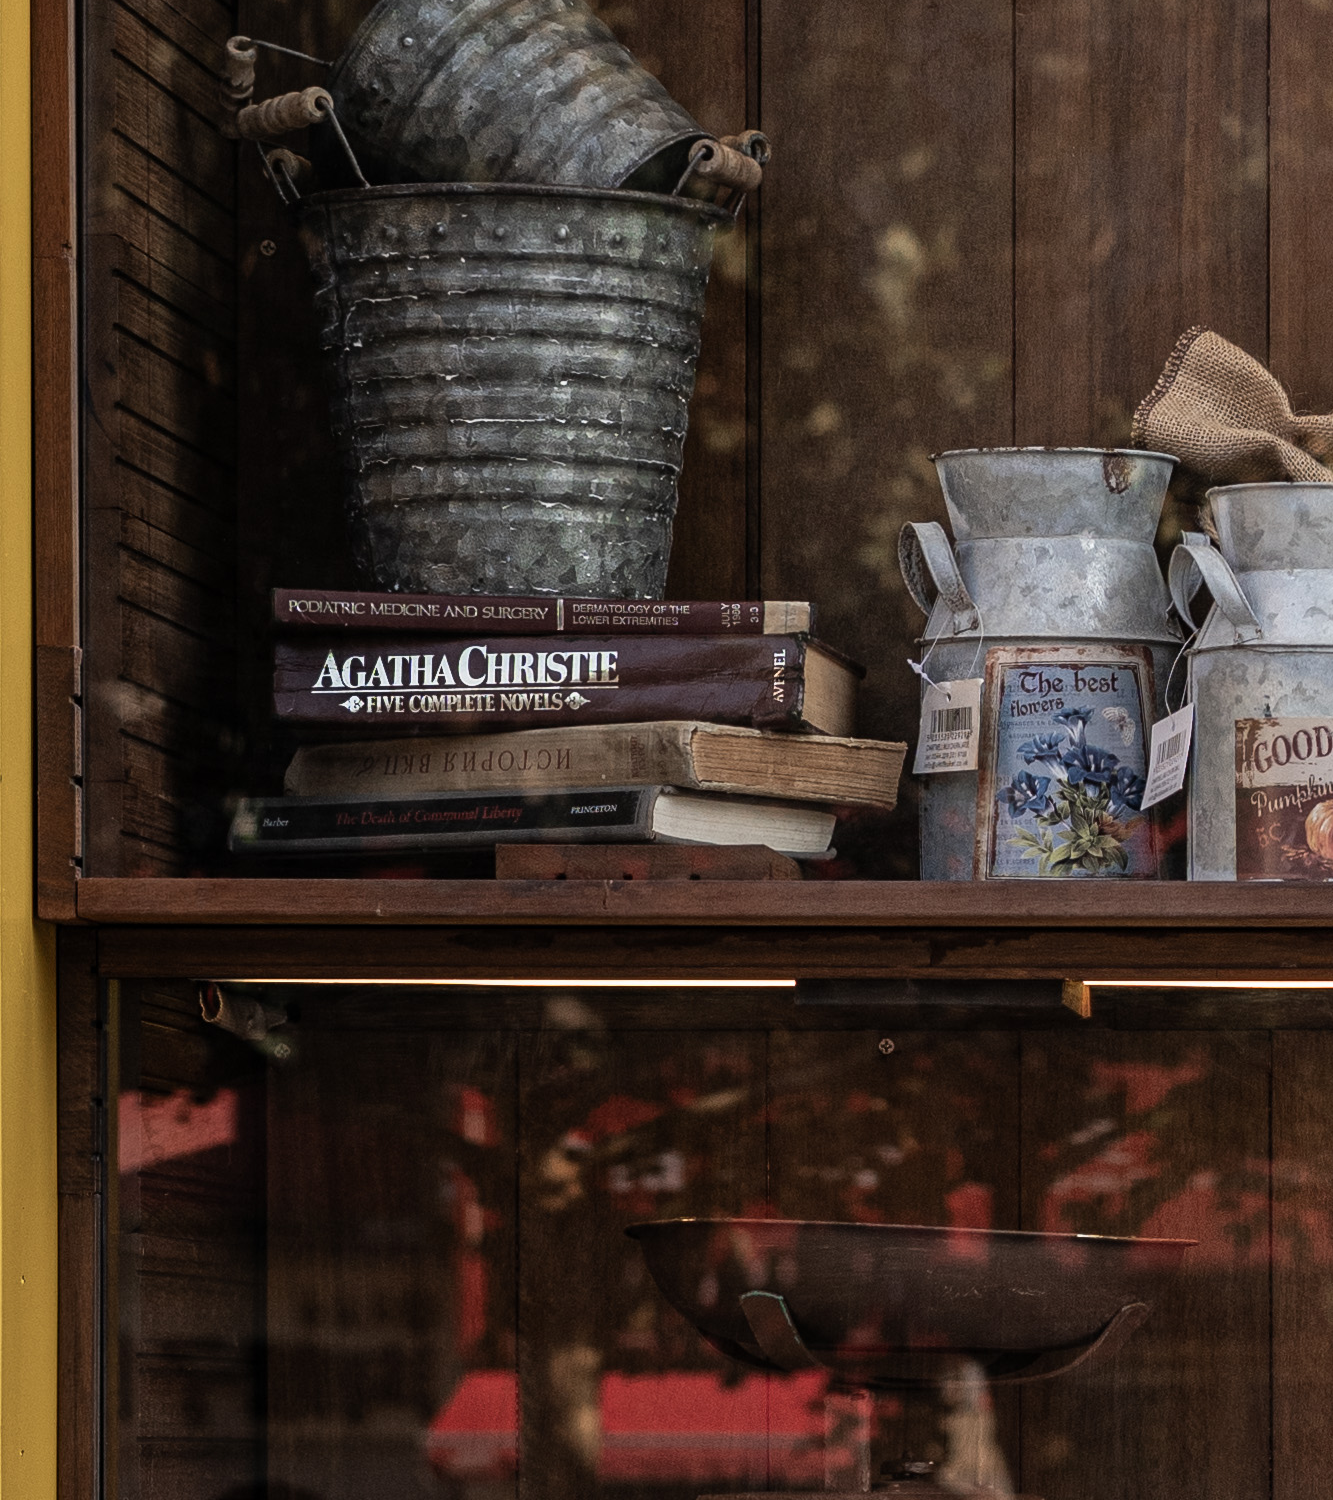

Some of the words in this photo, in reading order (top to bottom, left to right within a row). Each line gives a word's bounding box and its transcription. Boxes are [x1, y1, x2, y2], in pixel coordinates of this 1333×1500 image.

[288, 599, 365, 615] PODIATRIC
[370, 602, 440, 618] MEDICINE
[444, 604, 479, 619] AND
[482, 605, 549, 621] SURGERY
[572, 603, 650, 615] DERMATOLOGY
[652, 604, 667, 615] OF
[669, 604, 690, 615] THE
[720, 602, 731, 628] JULY
[572, 615, 610, 626] LOWER
[612, 615, 679, 627] EXTREMITIES
[312, 648, 457, 689] AGATHA
[458, 644, 620, 687] CHRISTIE
[772, 648, 787, 704] AVENEL
[1018, 670, 1064, 698] The
[1074, 671, 1119, 693] best
[366, 695, 405, 713] FIVE
[408, 694, 497, 713] COMPLETE
[499, 692, 564, 712] NOVELS
[1010, 696, 1065, 718] flowers
[1253, 725, 1333, 774] GOOD
[383, 753, 432, 777] ВКП
[442, 748, 573, 775] ИСТОРИЯ
[336, 811, 356, 826] The
[360, 809, 396, 826] Death
[399, 809, 413, 824] of
[414, 806, 480, 824] Communal
[482, 804, 524, 823] Liberty
[570, 803, 618, 815] PRINCETON
[262, 816, 290, 828] Barber
